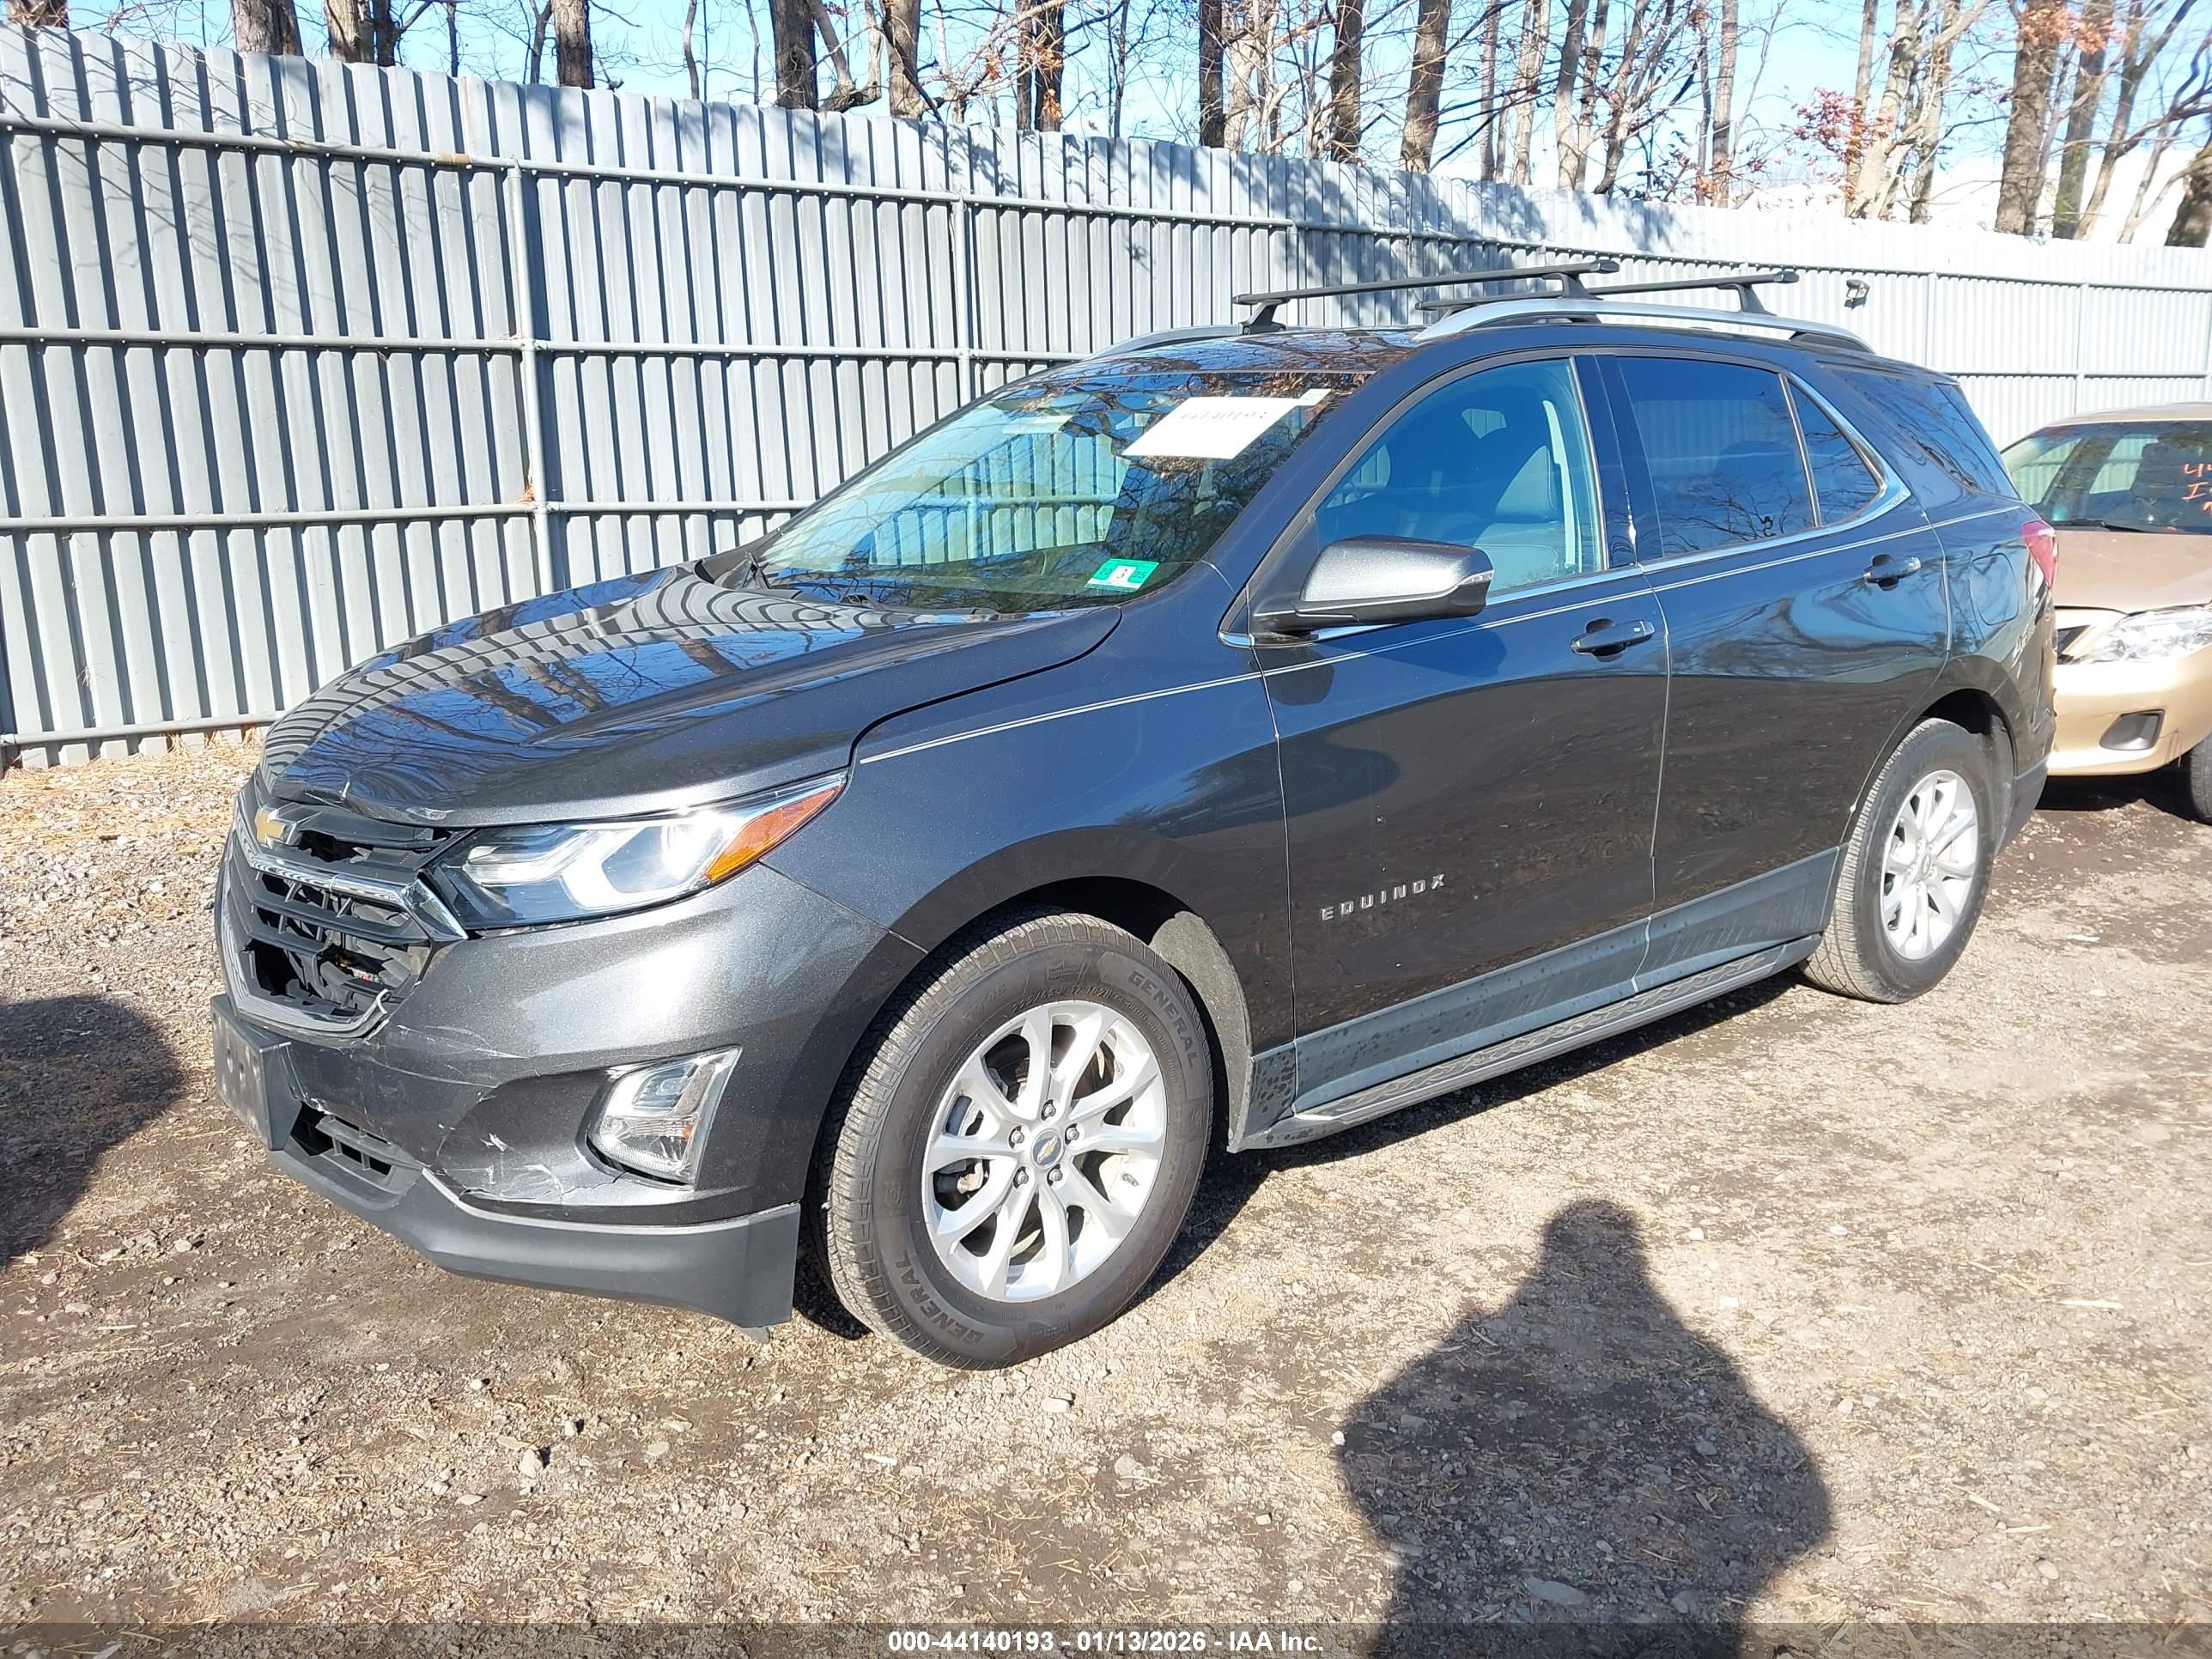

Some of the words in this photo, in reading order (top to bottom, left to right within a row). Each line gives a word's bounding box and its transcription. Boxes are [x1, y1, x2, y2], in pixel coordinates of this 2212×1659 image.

[1320, 873, 1445, 921] EQUINOX
[1126, 969, 1199, 1068] GENERAL
[896, 1249, 984, 1345] GENERAL
